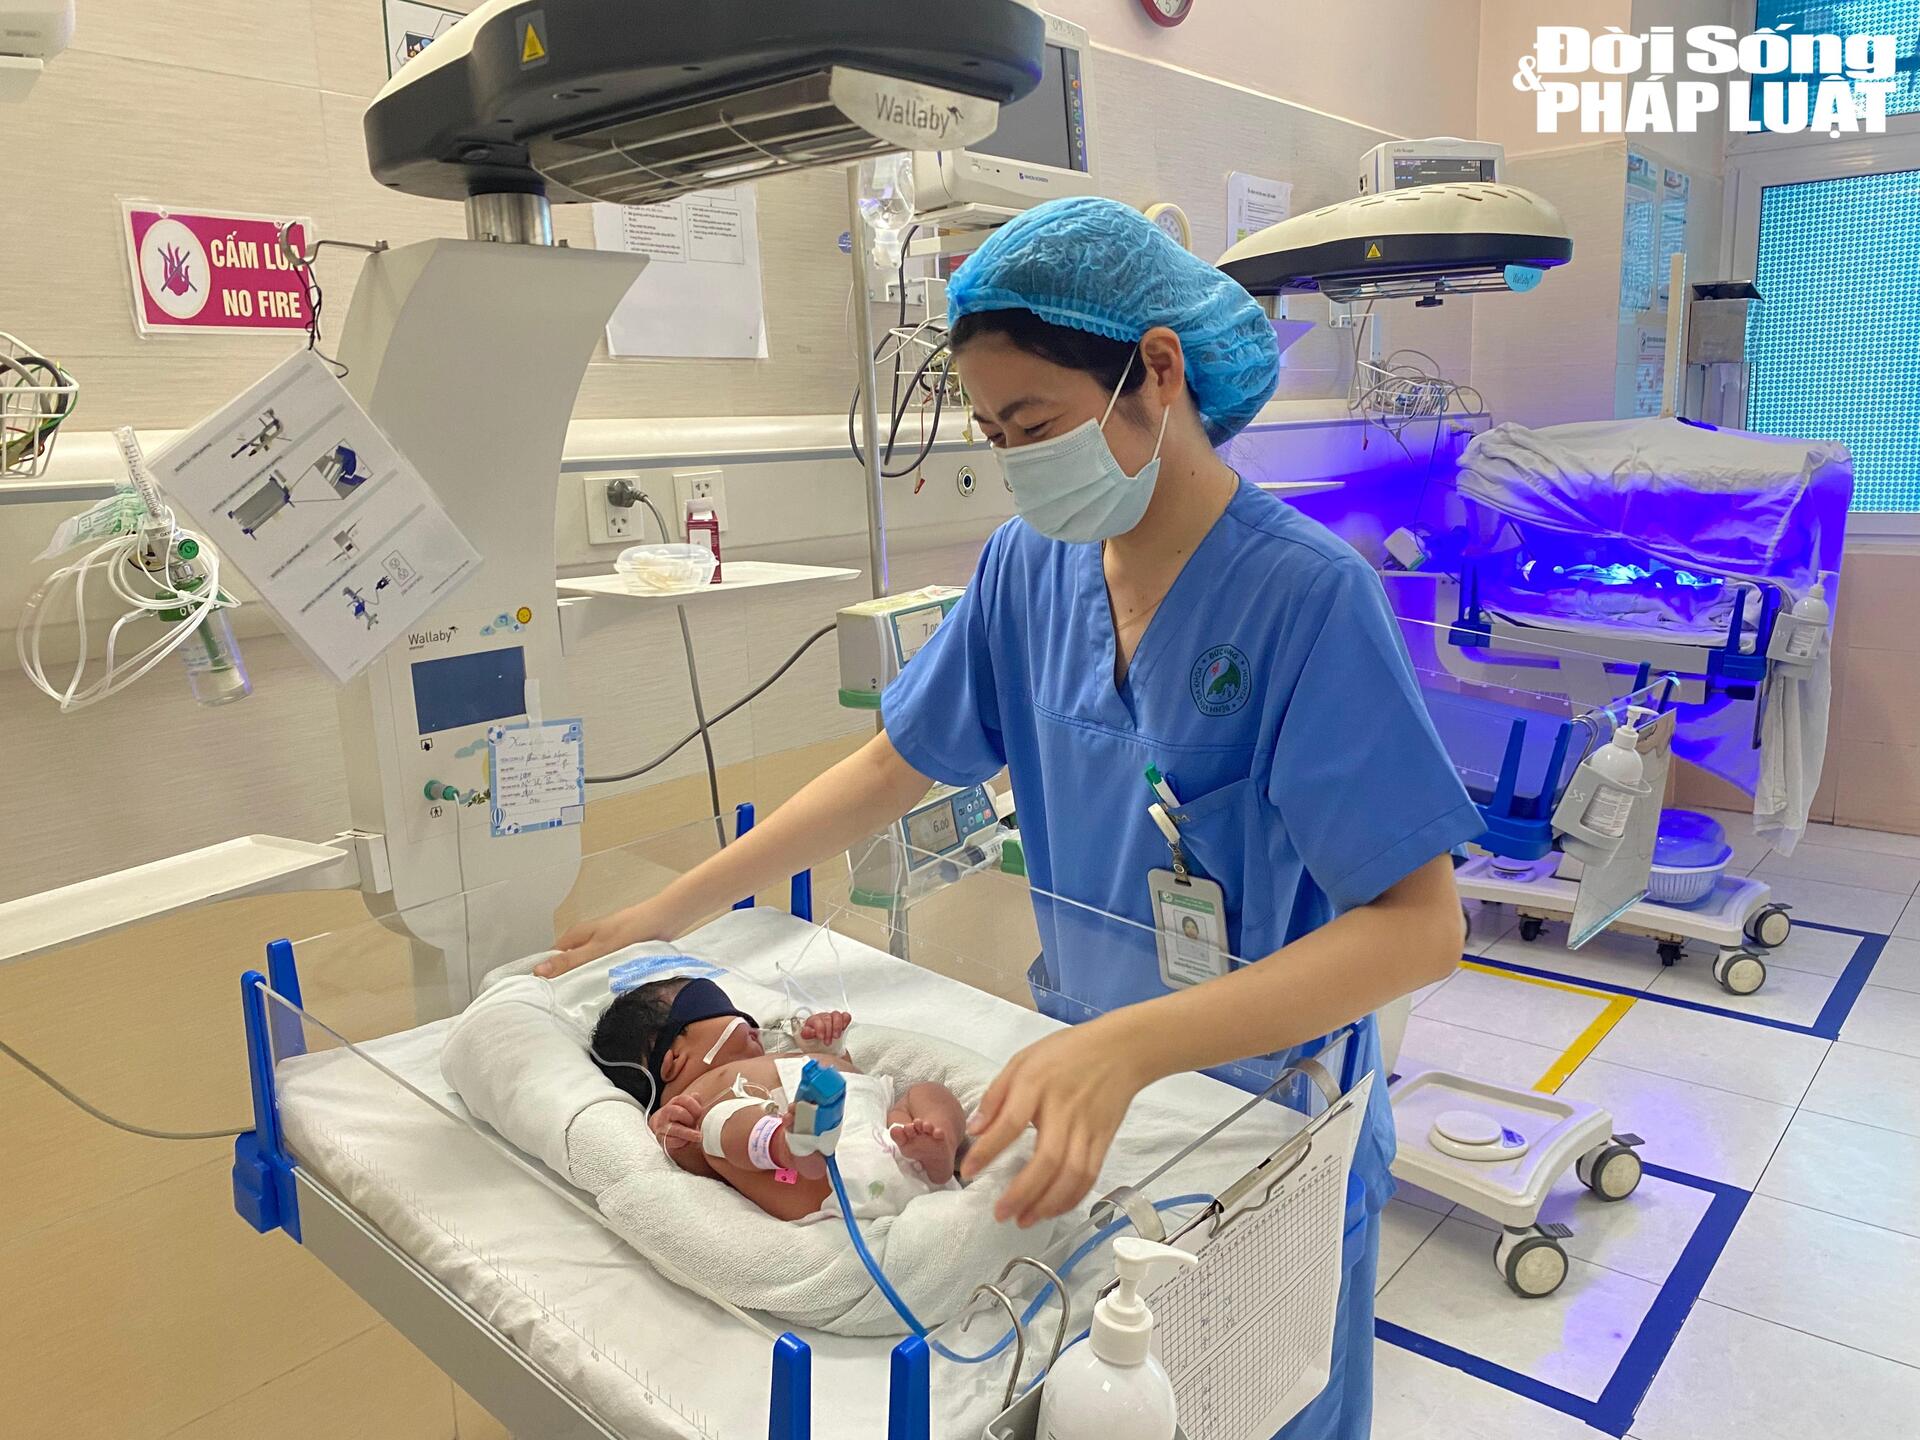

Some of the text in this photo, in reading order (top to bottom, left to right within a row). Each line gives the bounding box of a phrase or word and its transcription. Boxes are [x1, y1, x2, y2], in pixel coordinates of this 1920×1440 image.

[875, 92, 951, 139] Wallaby
[210, 230, 259, 270] CẤM
[222, 289, 302, 319] NO FIRE
[408, 630, 452, 646] Wallaby
[933, 818, 949, 833] 6.00
